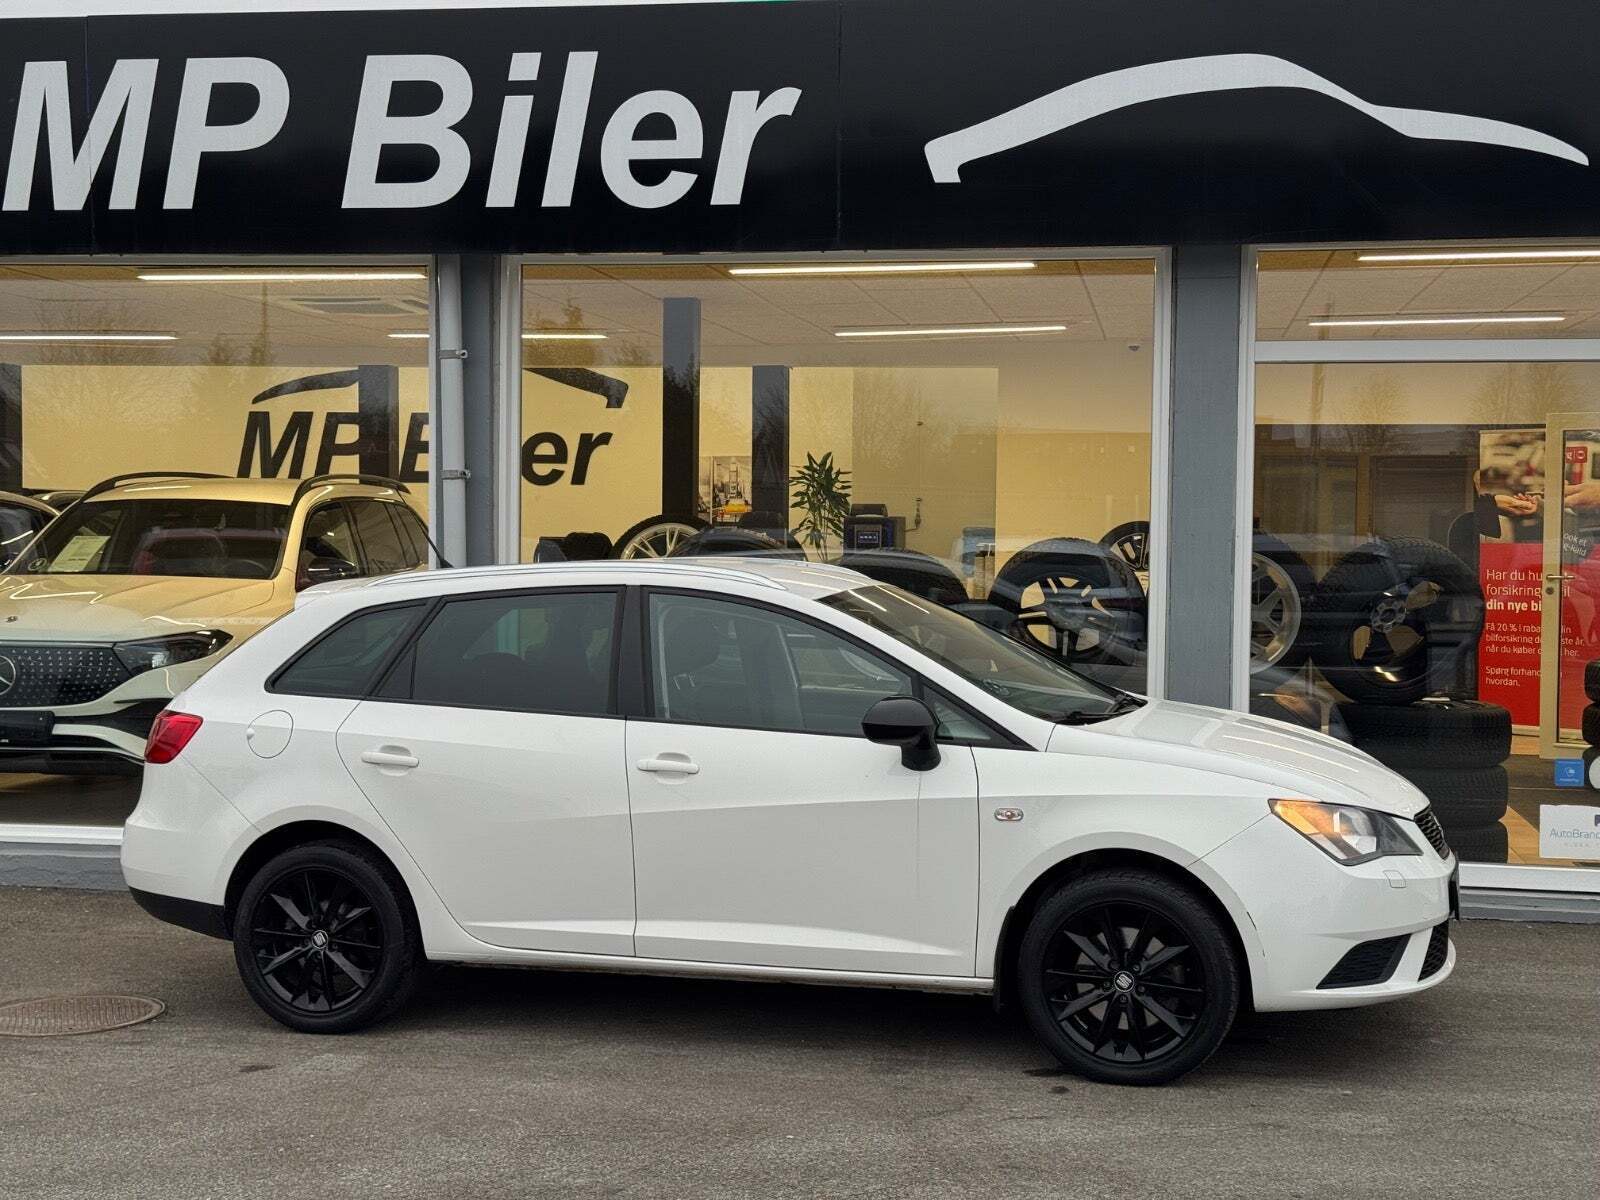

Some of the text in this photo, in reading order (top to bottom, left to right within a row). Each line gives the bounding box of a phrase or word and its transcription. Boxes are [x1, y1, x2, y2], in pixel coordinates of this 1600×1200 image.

[2, 51, 803, 211] MP Biler
[1486, 569, 1508, 581] Har
[1510, 569, 1525, 581] du
[1486, 584, 1541, 599] forsikring
[1486, 600, 1504, 611] din
[1507, 602, 1528, 613] nye
[1486, 623, 1495, 632] Få
[1497, 623, 1508, 632] 20
[1510, 624, 1518, 632] %
[1523, 624, 1541, 633] raba
[1486, 634, 1533, 644] bilforsikring
[1486, 644, 1499, 653] når
[1500, 646, 1511, 654] du
[1513, 646, 1536, 654] køber
[1486, 666, 1509, 676] Spørg
[1486, 677, 1520, 687] hvordan.
